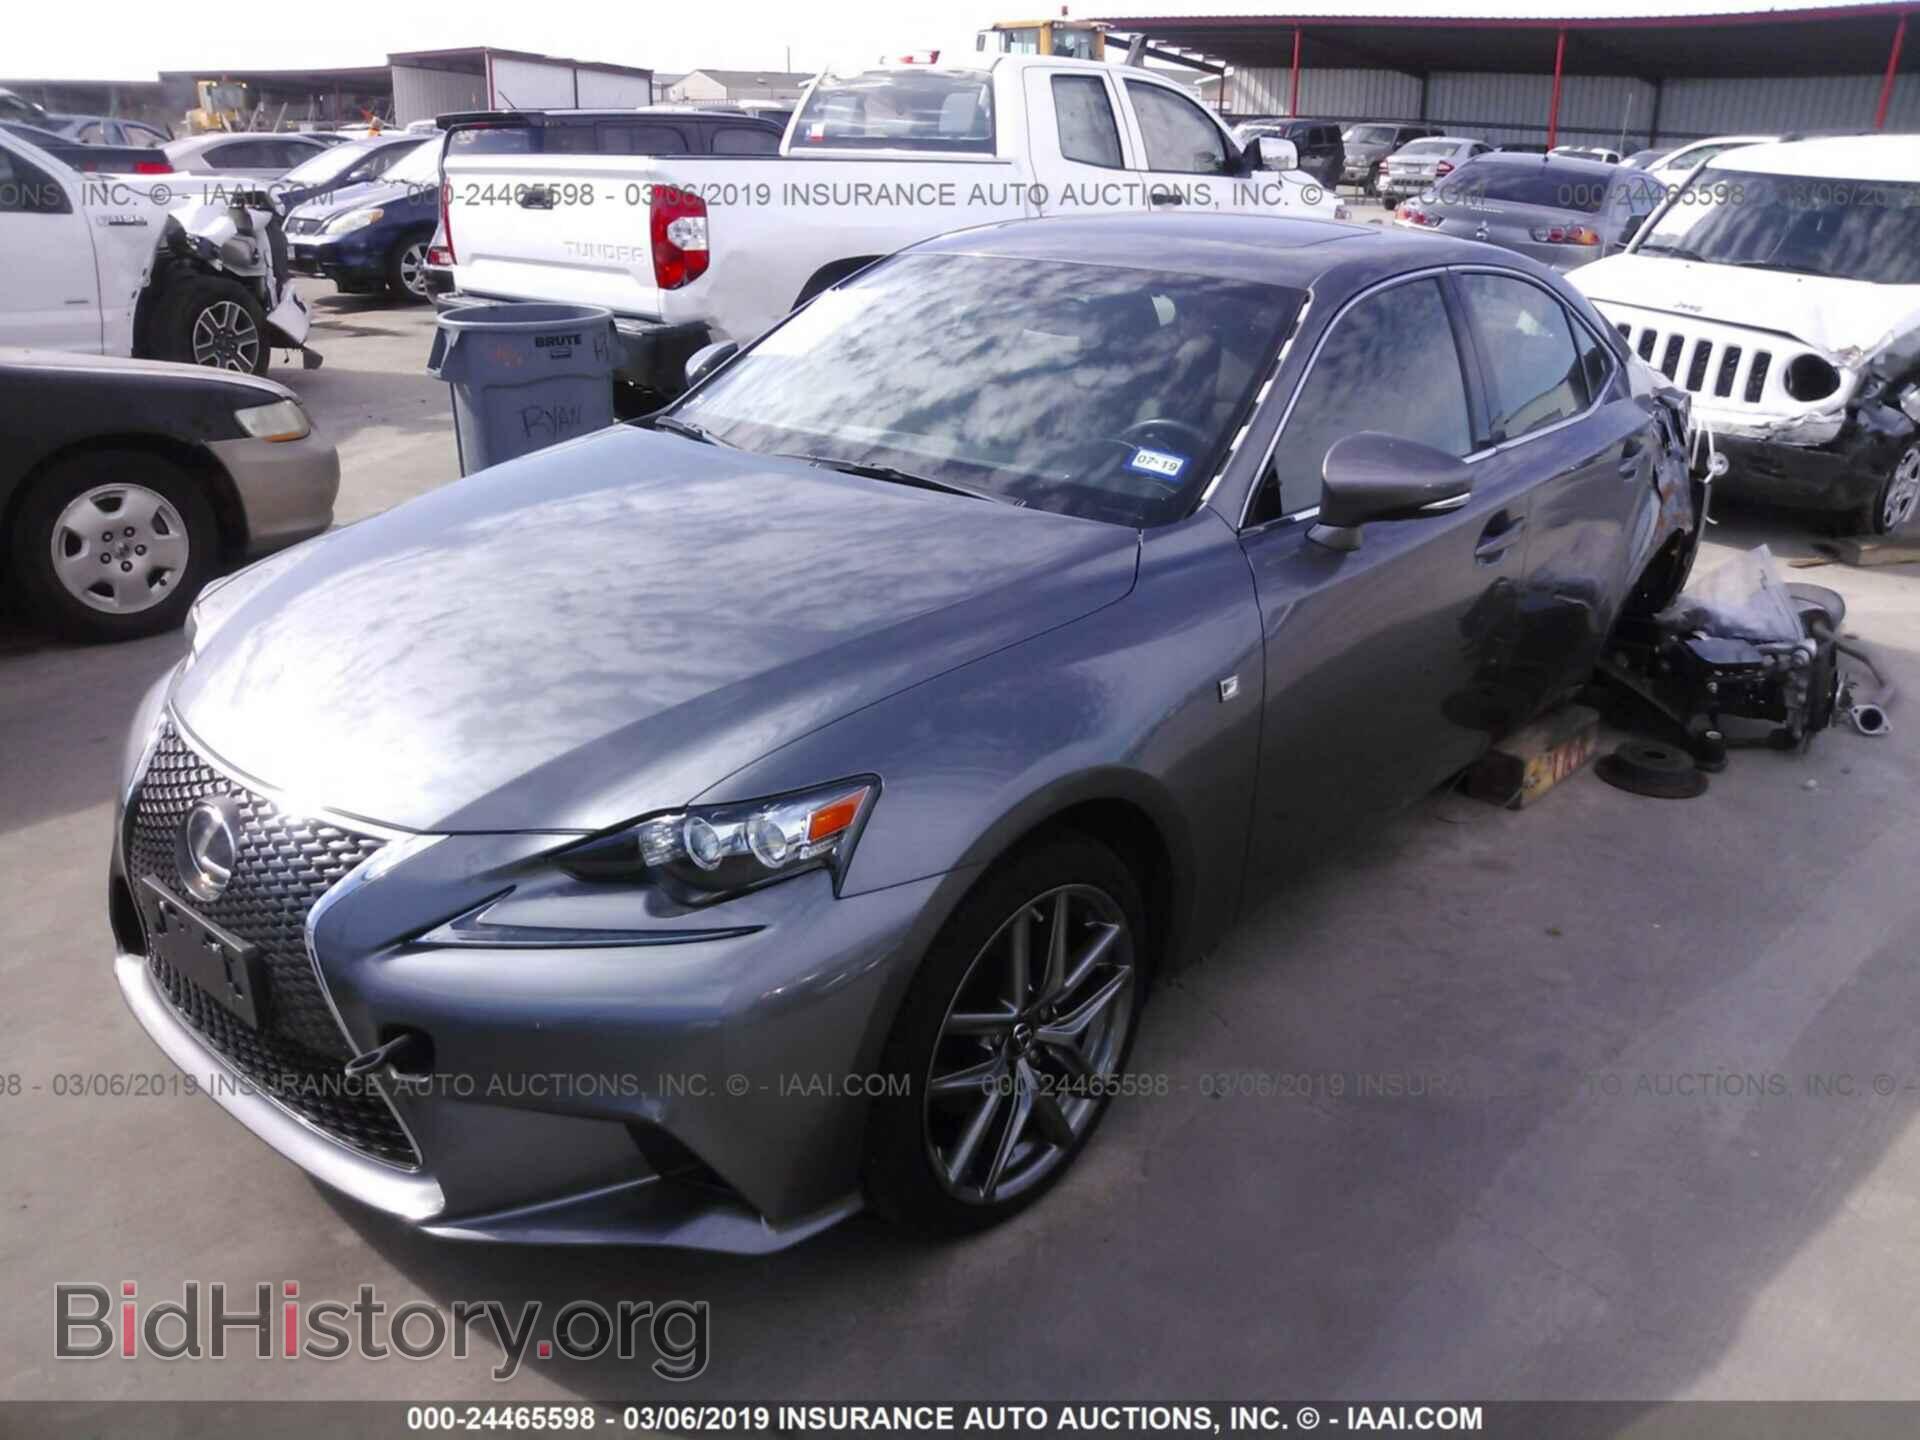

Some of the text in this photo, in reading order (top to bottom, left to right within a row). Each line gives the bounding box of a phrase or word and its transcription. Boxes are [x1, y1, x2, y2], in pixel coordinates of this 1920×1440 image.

[535, 334, 582, 348] BRUTE
[520, 404, 583, 438] RYAN
[1137, 454, 1179, 472] 07-19
